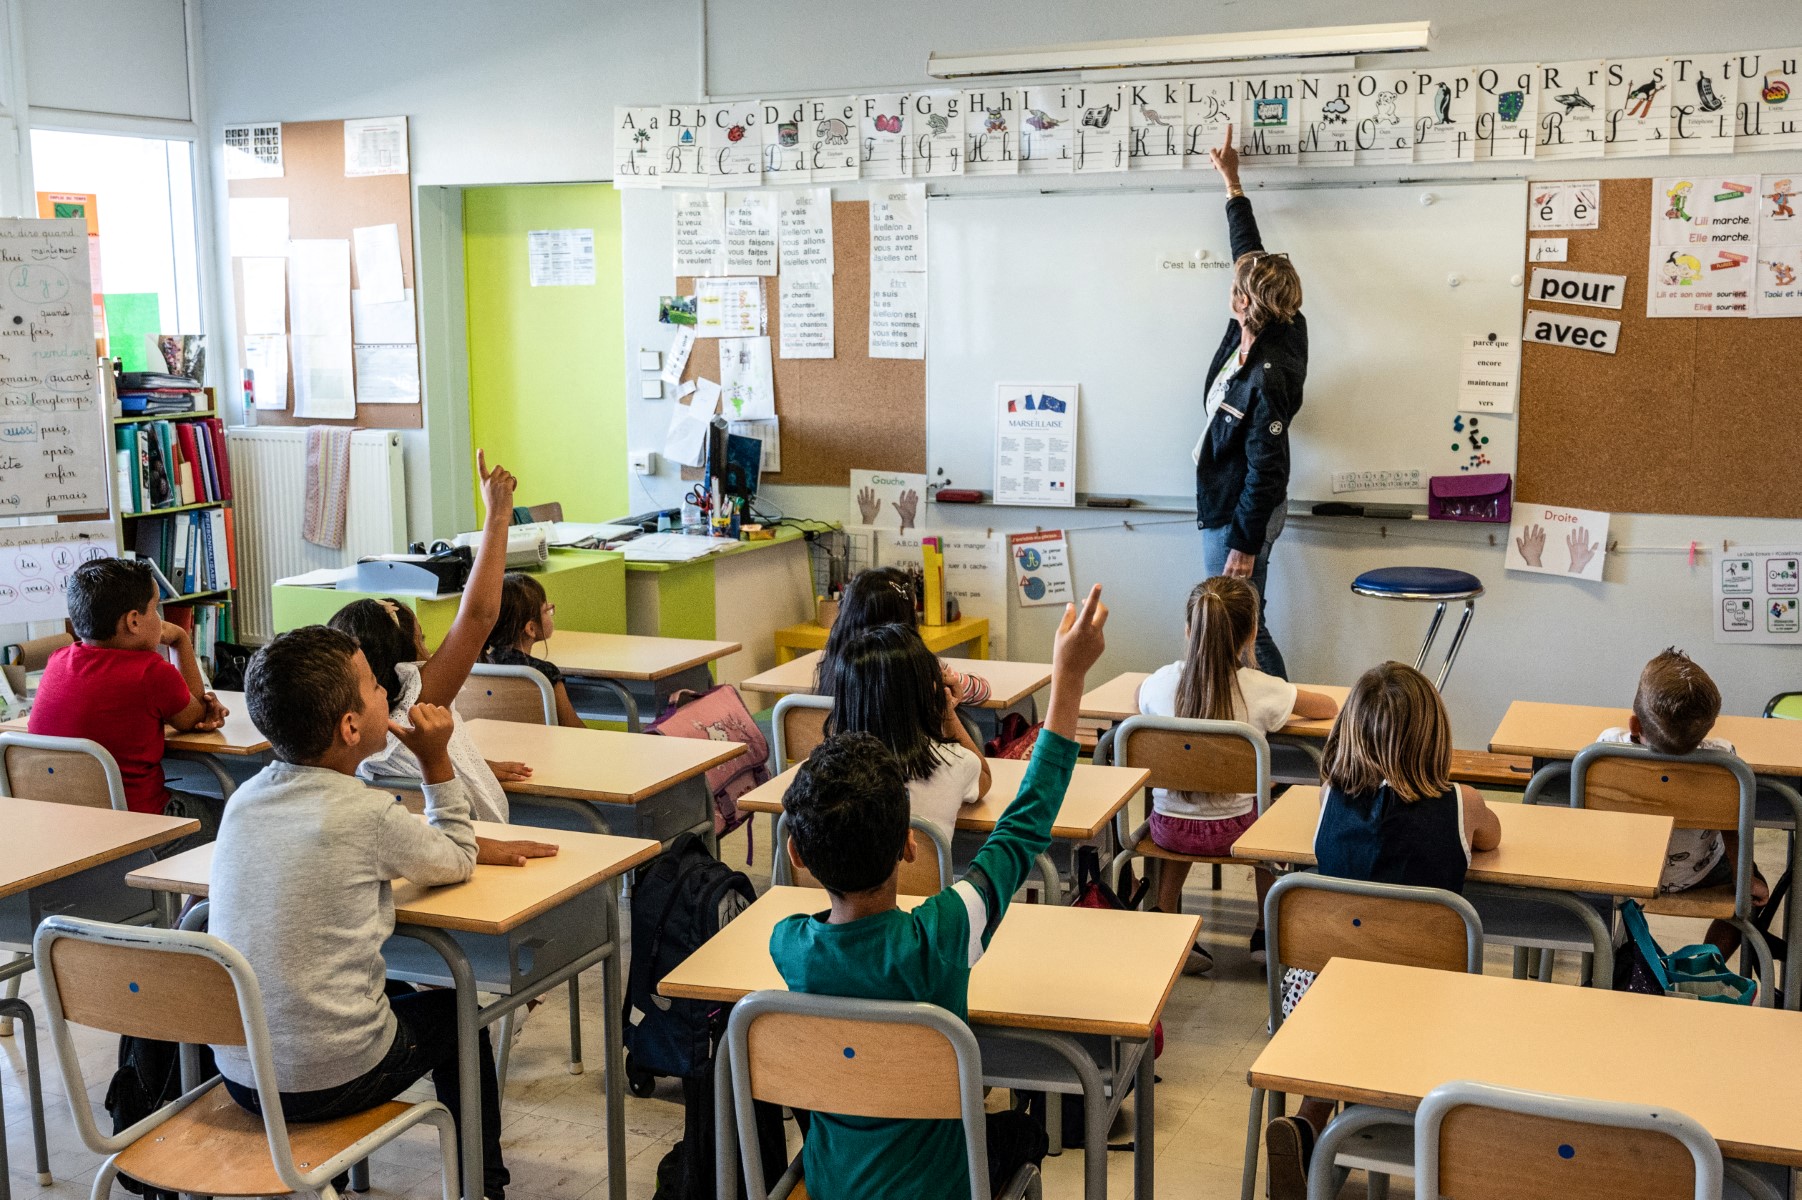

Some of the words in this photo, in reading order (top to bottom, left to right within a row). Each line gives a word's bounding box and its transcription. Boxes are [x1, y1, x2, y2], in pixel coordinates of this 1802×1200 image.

[1609, 64, 1623, 86] S
[1653, 68, 1662, 83] s
[1674, 60, 1692, 81] T
[1723, 61, 1732, 79] t
[1740, 56, 1760, 78] U
[1782, 59, 1797, 75] u
[1302, 79, 1319, 99] N
[1338, 83, 1350, 98] n
[1358, 76, 1376, 96] O
[1395, 80, 1408, 94] o
[1418, 74, 1432, 94] P
[1456, 77, 1468, 98] p
[1478, 69, 1499, 95] Q
[1518, 74, 1530, 94] q
[1543, 68, 1562, 89] R
[1588, 70, 1598, 86] r
[1023, 91, 1029, 109] I
[1061, 88, 1066, 108] i
[1077, 89, 1086, 108] J
[1114, 86, 1122, 111] j
[1132, 86, 1149, 105] K
[1165, 84, 1178, 104] k
[1188, 84, 1202, 102] L
[1229, 81, 1234, 101] l
[1246, 80, 1268, 100] M
[1274, 83, 1294, 98] m
[813, 103, 825, 121] E
[844, 106, 853, 118] e
[865, 99, 876, 117] F
[899, 96, 908, 115] f
[916, 96, 932, 114] G
[948, 99, 958, 117] g
[969, 93, 985, 112] H
[1001, 92, 1012, 111] h
[622, 112, 635, 128] A
[650, 117, 658, 129] a
[669, 109, 680, 126] B
[697, 109, 706, 127] b
[716, 110, 729, 128] C
[746, 113, 754, 126] c
[765, 106, 779, 124] D
[793, 104, 804, 123] d
[1670, 105, 1695, 139] T
[1736, 102, 1762, 135] U
[1356, 119, 1376, 149] O
[1416, 116, 1432, 144] P
[1476, 113, 1495, 156] Q
[1542, 112, 1565, 145] R
[1605, 109, 1624, 142] S
[968, 133, 989, 162] H
[1130, 127, 1149, 156] K
[1186, 124, 1204, 155] L
[1244, 129, 1271, 155] M
[1300, 122, 1326, 152] N
[666, 146, 682, 173] B
[764, 144, 782, 171] D
[813, 141, 824, 169] E
[864, 138, 876, 161] F
[916, 134, 932, 173] G
[1077, 129, 1084, 169] J
[621, 149, 640, 175] A
[716, 147, 732, 174] C
[1541, 197, 1553, 220] é
[1574, 197, 1587, 219] è
[1694, 216, 1708, 226] Lili
[1712, 216, 1751, 225] marche.
[42, 228, 76, 245] quand
[1689, 233, 1708, 242] Elle
[1712, 232, 1750, 242] marche.
[1536, 240, 1559, 260] j'ai
[1163, 261, 1183, 269] C'est
[1541, 278, 1615, 302] pour
[41, 306, 69, 323] quand
[2, 328, 26, 336] une
[1535, 322, 1608, 348] avec
[4, 396, 27, 406] très
[4, 424, 34, 436] aussi
[42, 446, 74, 462] après
[45, 465, 76, 484] enfin
[872, 475, 905, 486] Gauche
[46, 492, 87, 508] jamais
[1544, 510, 1578, 524] Droite
[21, 560, 36, 569] tu
[58, 551, 70, 565] il
[204, 512, 216, 590] PERSONNALISABLE
